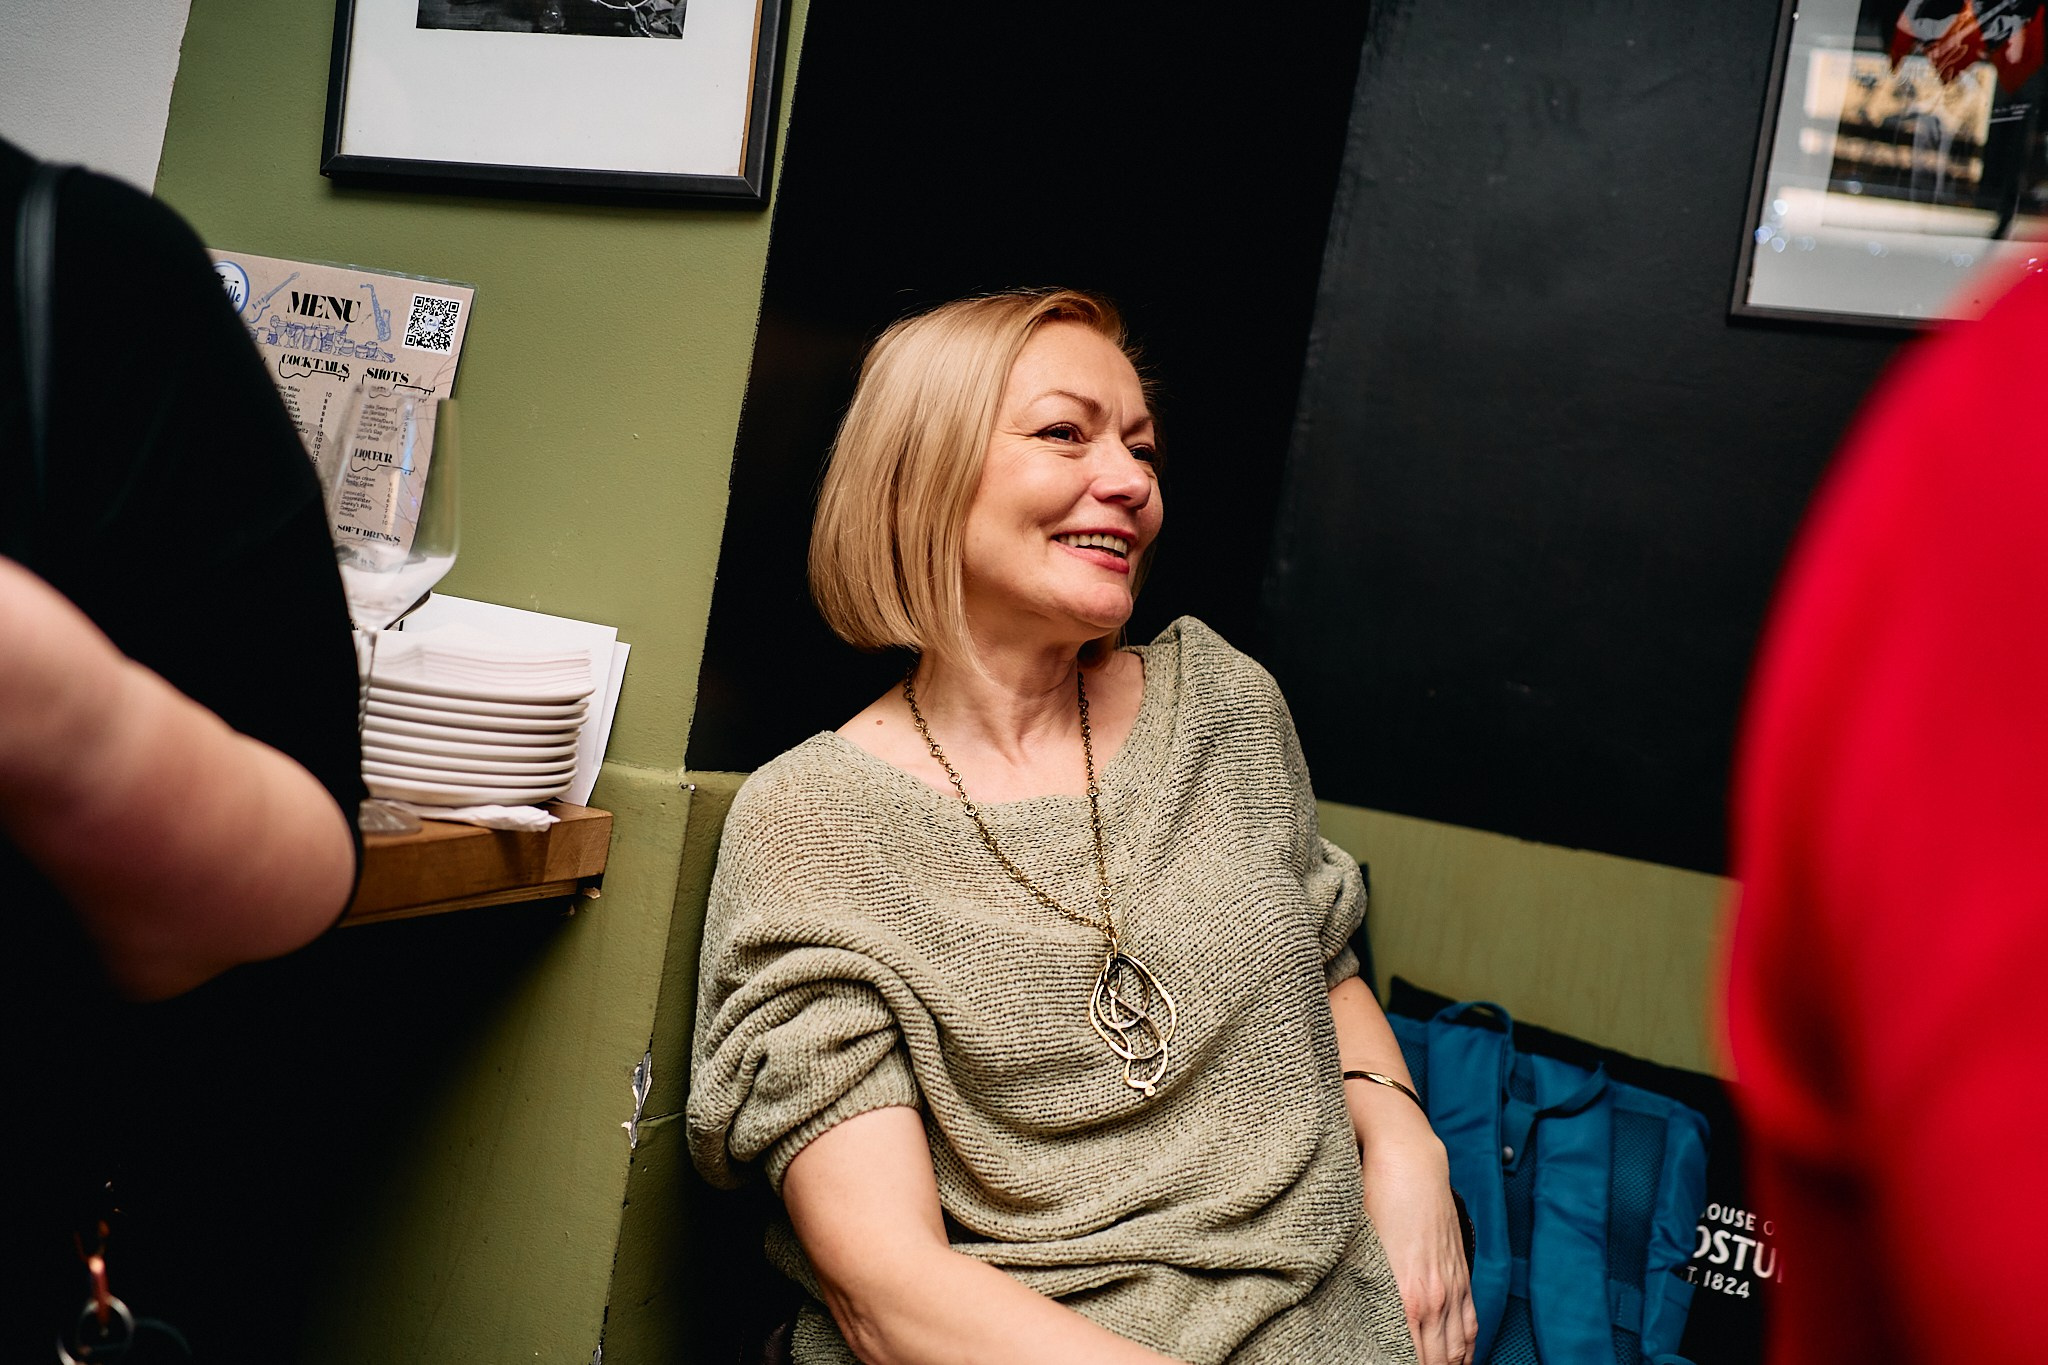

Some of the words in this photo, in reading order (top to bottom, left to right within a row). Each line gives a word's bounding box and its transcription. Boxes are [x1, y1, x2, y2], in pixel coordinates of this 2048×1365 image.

[287, 291, 361, 324] MENU
[281, 353, 350, 374] COCKTAILS
[366, 367, 409, 384] SHOTS
[353, 447, 393, 463] LIQUEUR
[337, 524, 362, 535] SOFT
[363, 529, 401, 543] DRINKS
[1702, 1203, 1757, 1231] OUSE
[1693, 1225, 1783, 1284] OSTU
[1703, 1269, 1751, 1299] 1824
